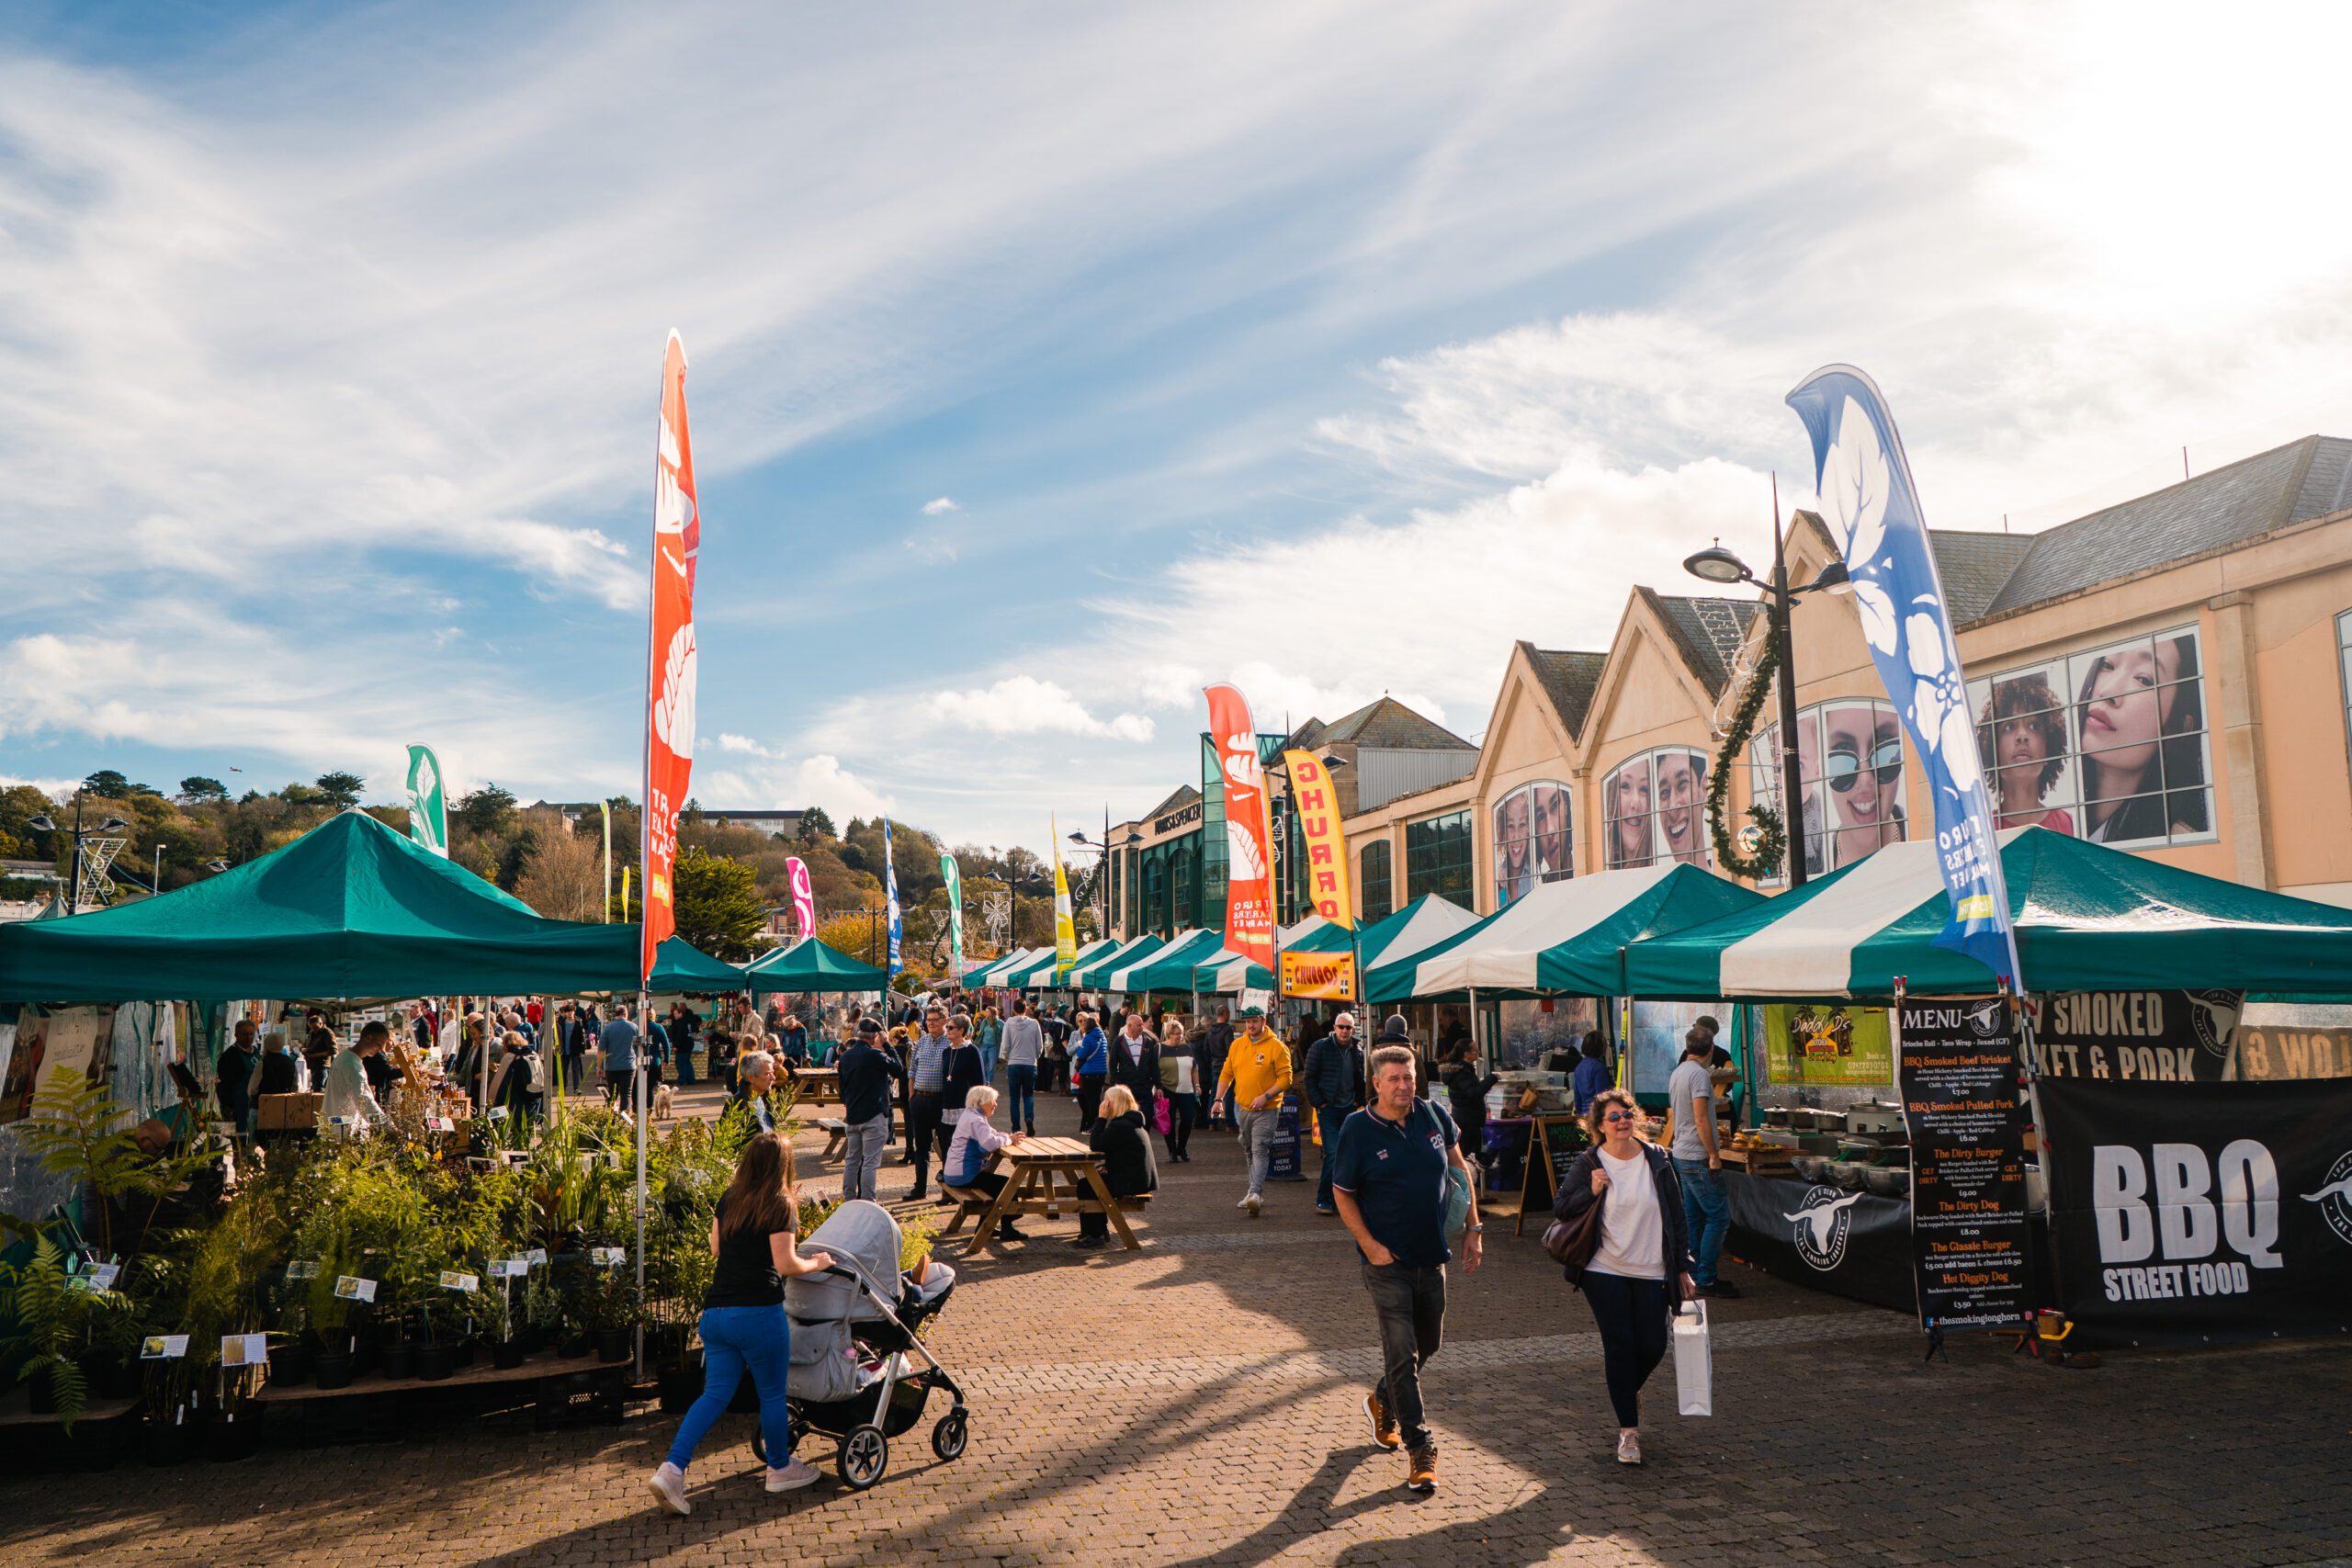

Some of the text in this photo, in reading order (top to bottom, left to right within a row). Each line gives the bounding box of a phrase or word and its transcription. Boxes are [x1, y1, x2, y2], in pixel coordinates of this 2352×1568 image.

[1295, 965, 1339, 986] CHURROS
[1902, 1010, 1962, 1029] MENU
[2054, 993, 2164, 1036] SMOKED
[1792, 1015, 1851, 1033] Daddy D's
[1924, 1039, 1936, 1047] Roll
[1941, 1039, 1954, 1047] Taco
[1955, 1038, 1972, 1046] Wrap
[1996, 1038, 2010, 1046] (GF)
[1904, 1055, 2011, 1067] BBQ Smoked Beef Brisket
[2090, 1045, 2109, 1078] &
[2118, 1046, 2196, 1081] PORK
[1909, 1100, 2014, 1113] BBQ Smoked Pulled Pork
[1430, 1134, 1444, 1149] 28
[1934, 1147, 2004, 1159] The Dirty Burger
[1918, 1177, 1938, 1185] DIRTY
[2001, 1174, 2022, 1182] DIRTY
[1939, 1199, 2000, 1212] The Dirty Dog
[2093, 1139, 2284, 1269] BBQ
[2334, 1216, 2348, 1232] THE
[1931, 1243, 1948, 1253] The
[1983, 1240, 2011, 1251] Burger
[1925, 1262, 1943, 1270] £5.00
[1944, 1261, 1957, 1269] add
[1957, 1260, 1976, 1269] bacon
[1983, 1259, 2003, 1268] cheese
[2004, 1258, 2022, 1267] £6.50
[1942, 1271, 2009, 1285] Hot Diggity Dog
[2103, 1262, 2249, 1302] STREET FOOD
[1939, 1313, 2020, 1325] thesmokinglonghorn
